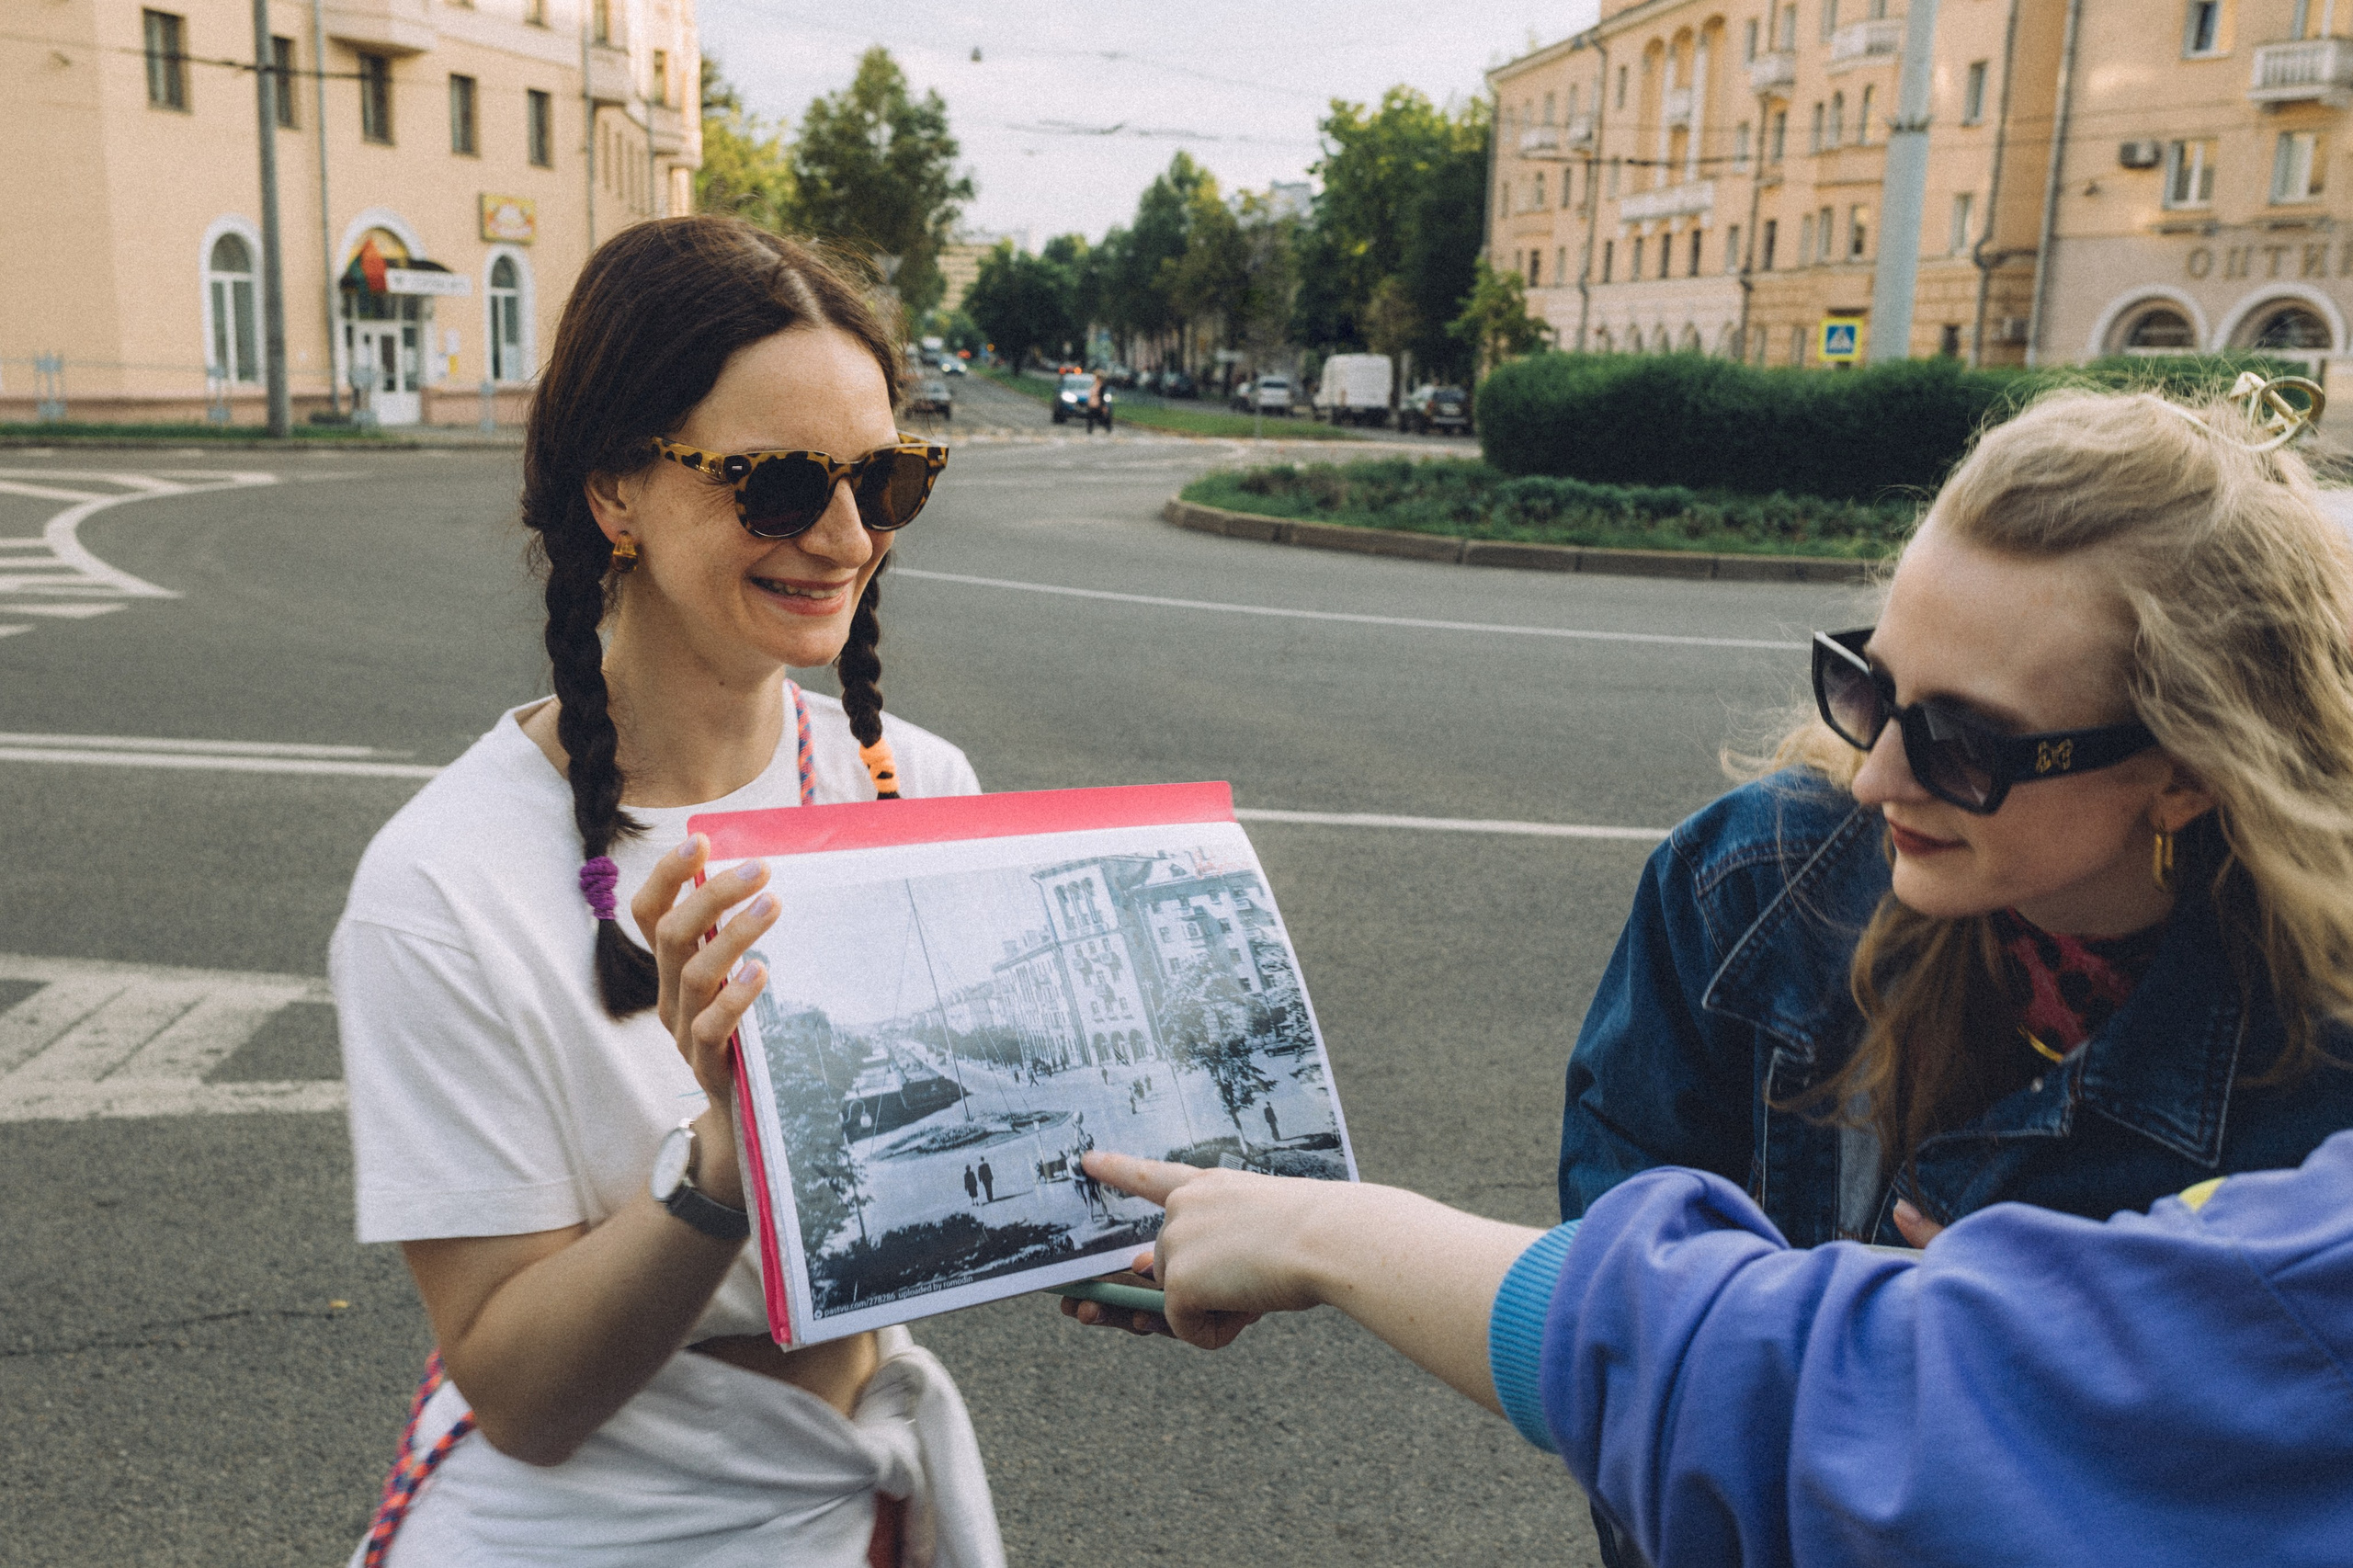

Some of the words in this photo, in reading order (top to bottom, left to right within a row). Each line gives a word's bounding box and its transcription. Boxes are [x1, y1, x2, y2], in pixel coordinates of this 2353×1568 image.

[824, 1292, 896, 1318] pastvu.com/278286
[898, 1283, 932, 1300] uploaded
[933, 1282, 942, 1291] by
[943, 1275, 973, 1288] romodin
